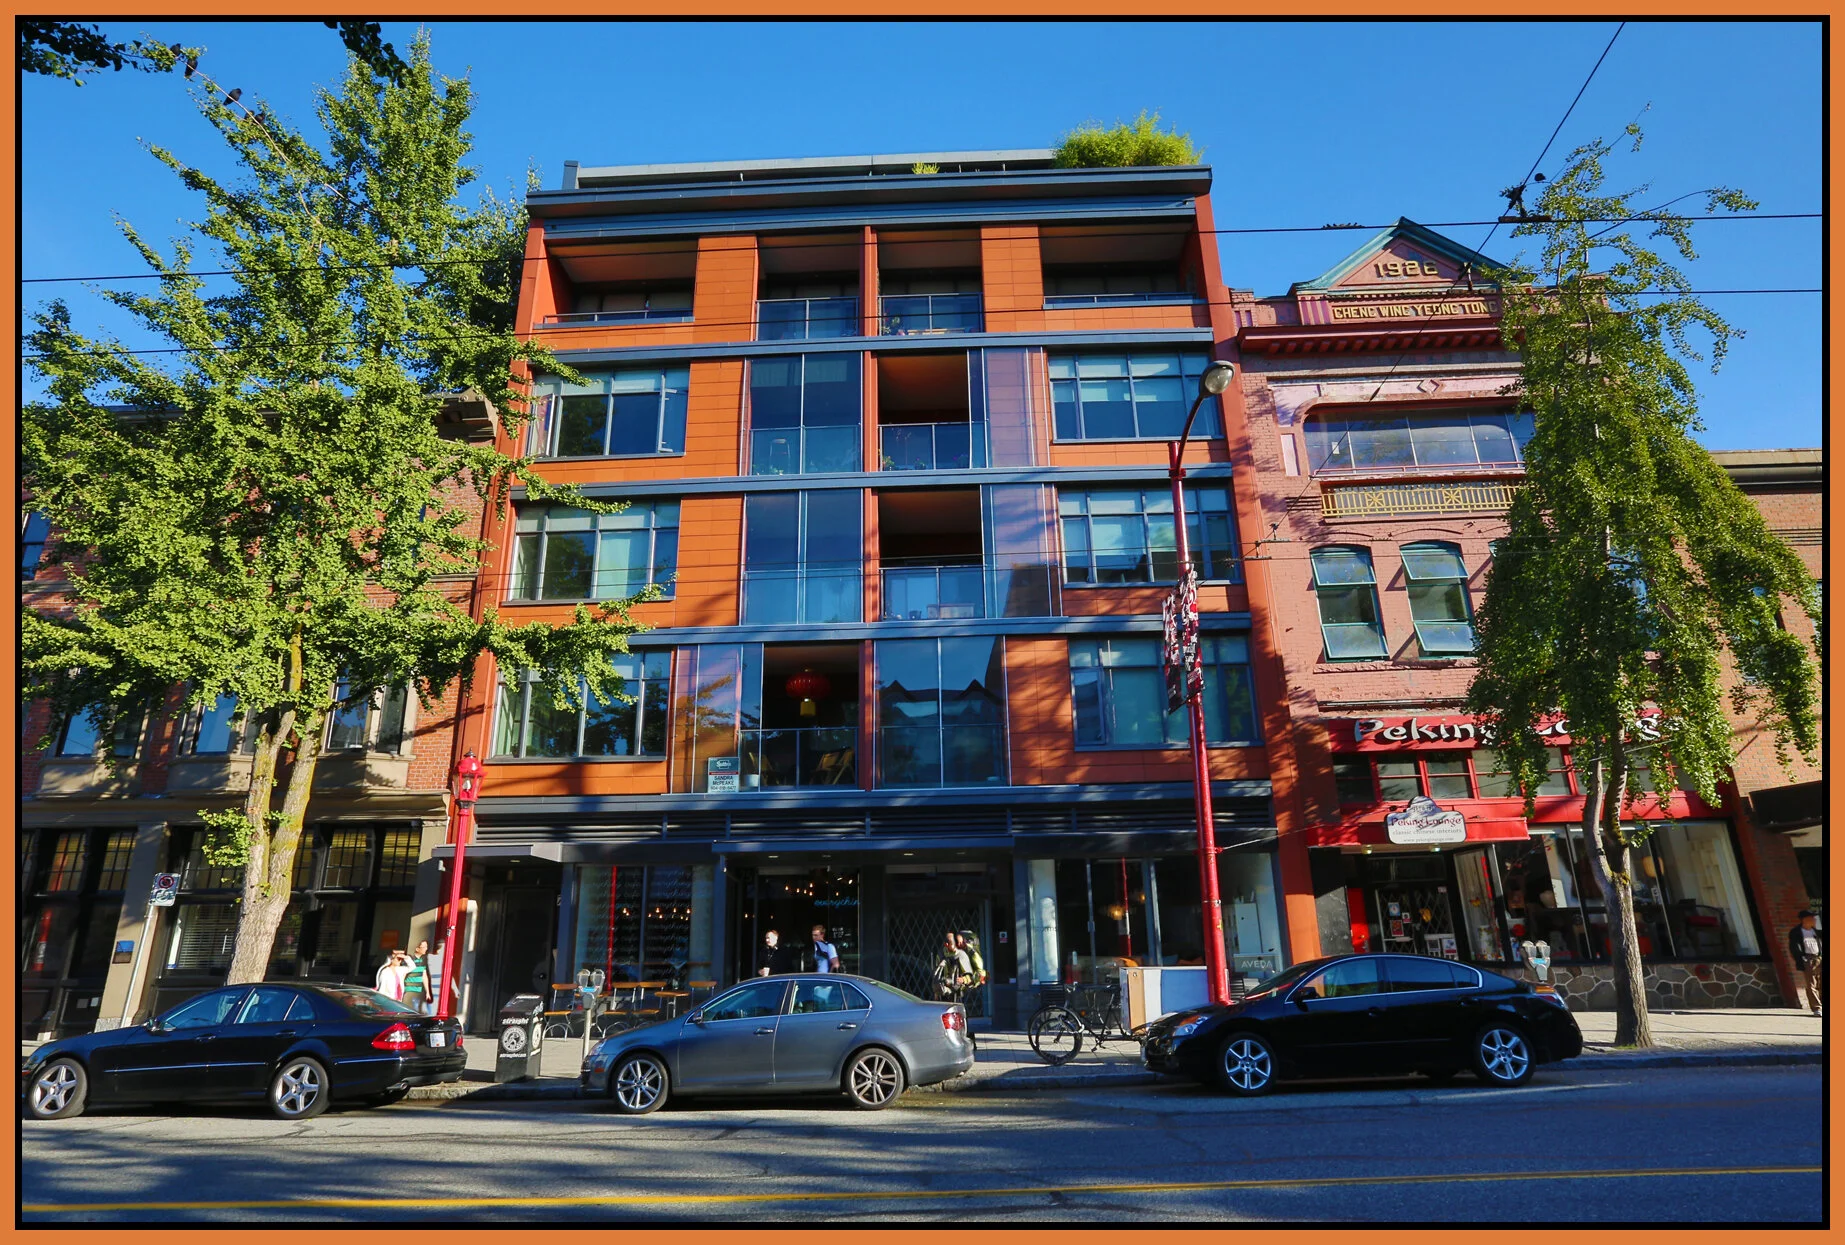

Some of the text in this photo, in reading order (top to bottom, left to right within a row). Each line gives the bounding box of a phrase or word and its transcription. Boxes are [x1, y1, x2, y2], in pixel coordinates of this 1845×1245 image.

[1334, 306, 1376, 319] CHENG
[1378, 304, 1410, 317] WING
[1460, 301, 1497, 314] TONG
[1391, 817, 1423, 829] Peking
[1241, 960, 1273, 968] AVEDA
